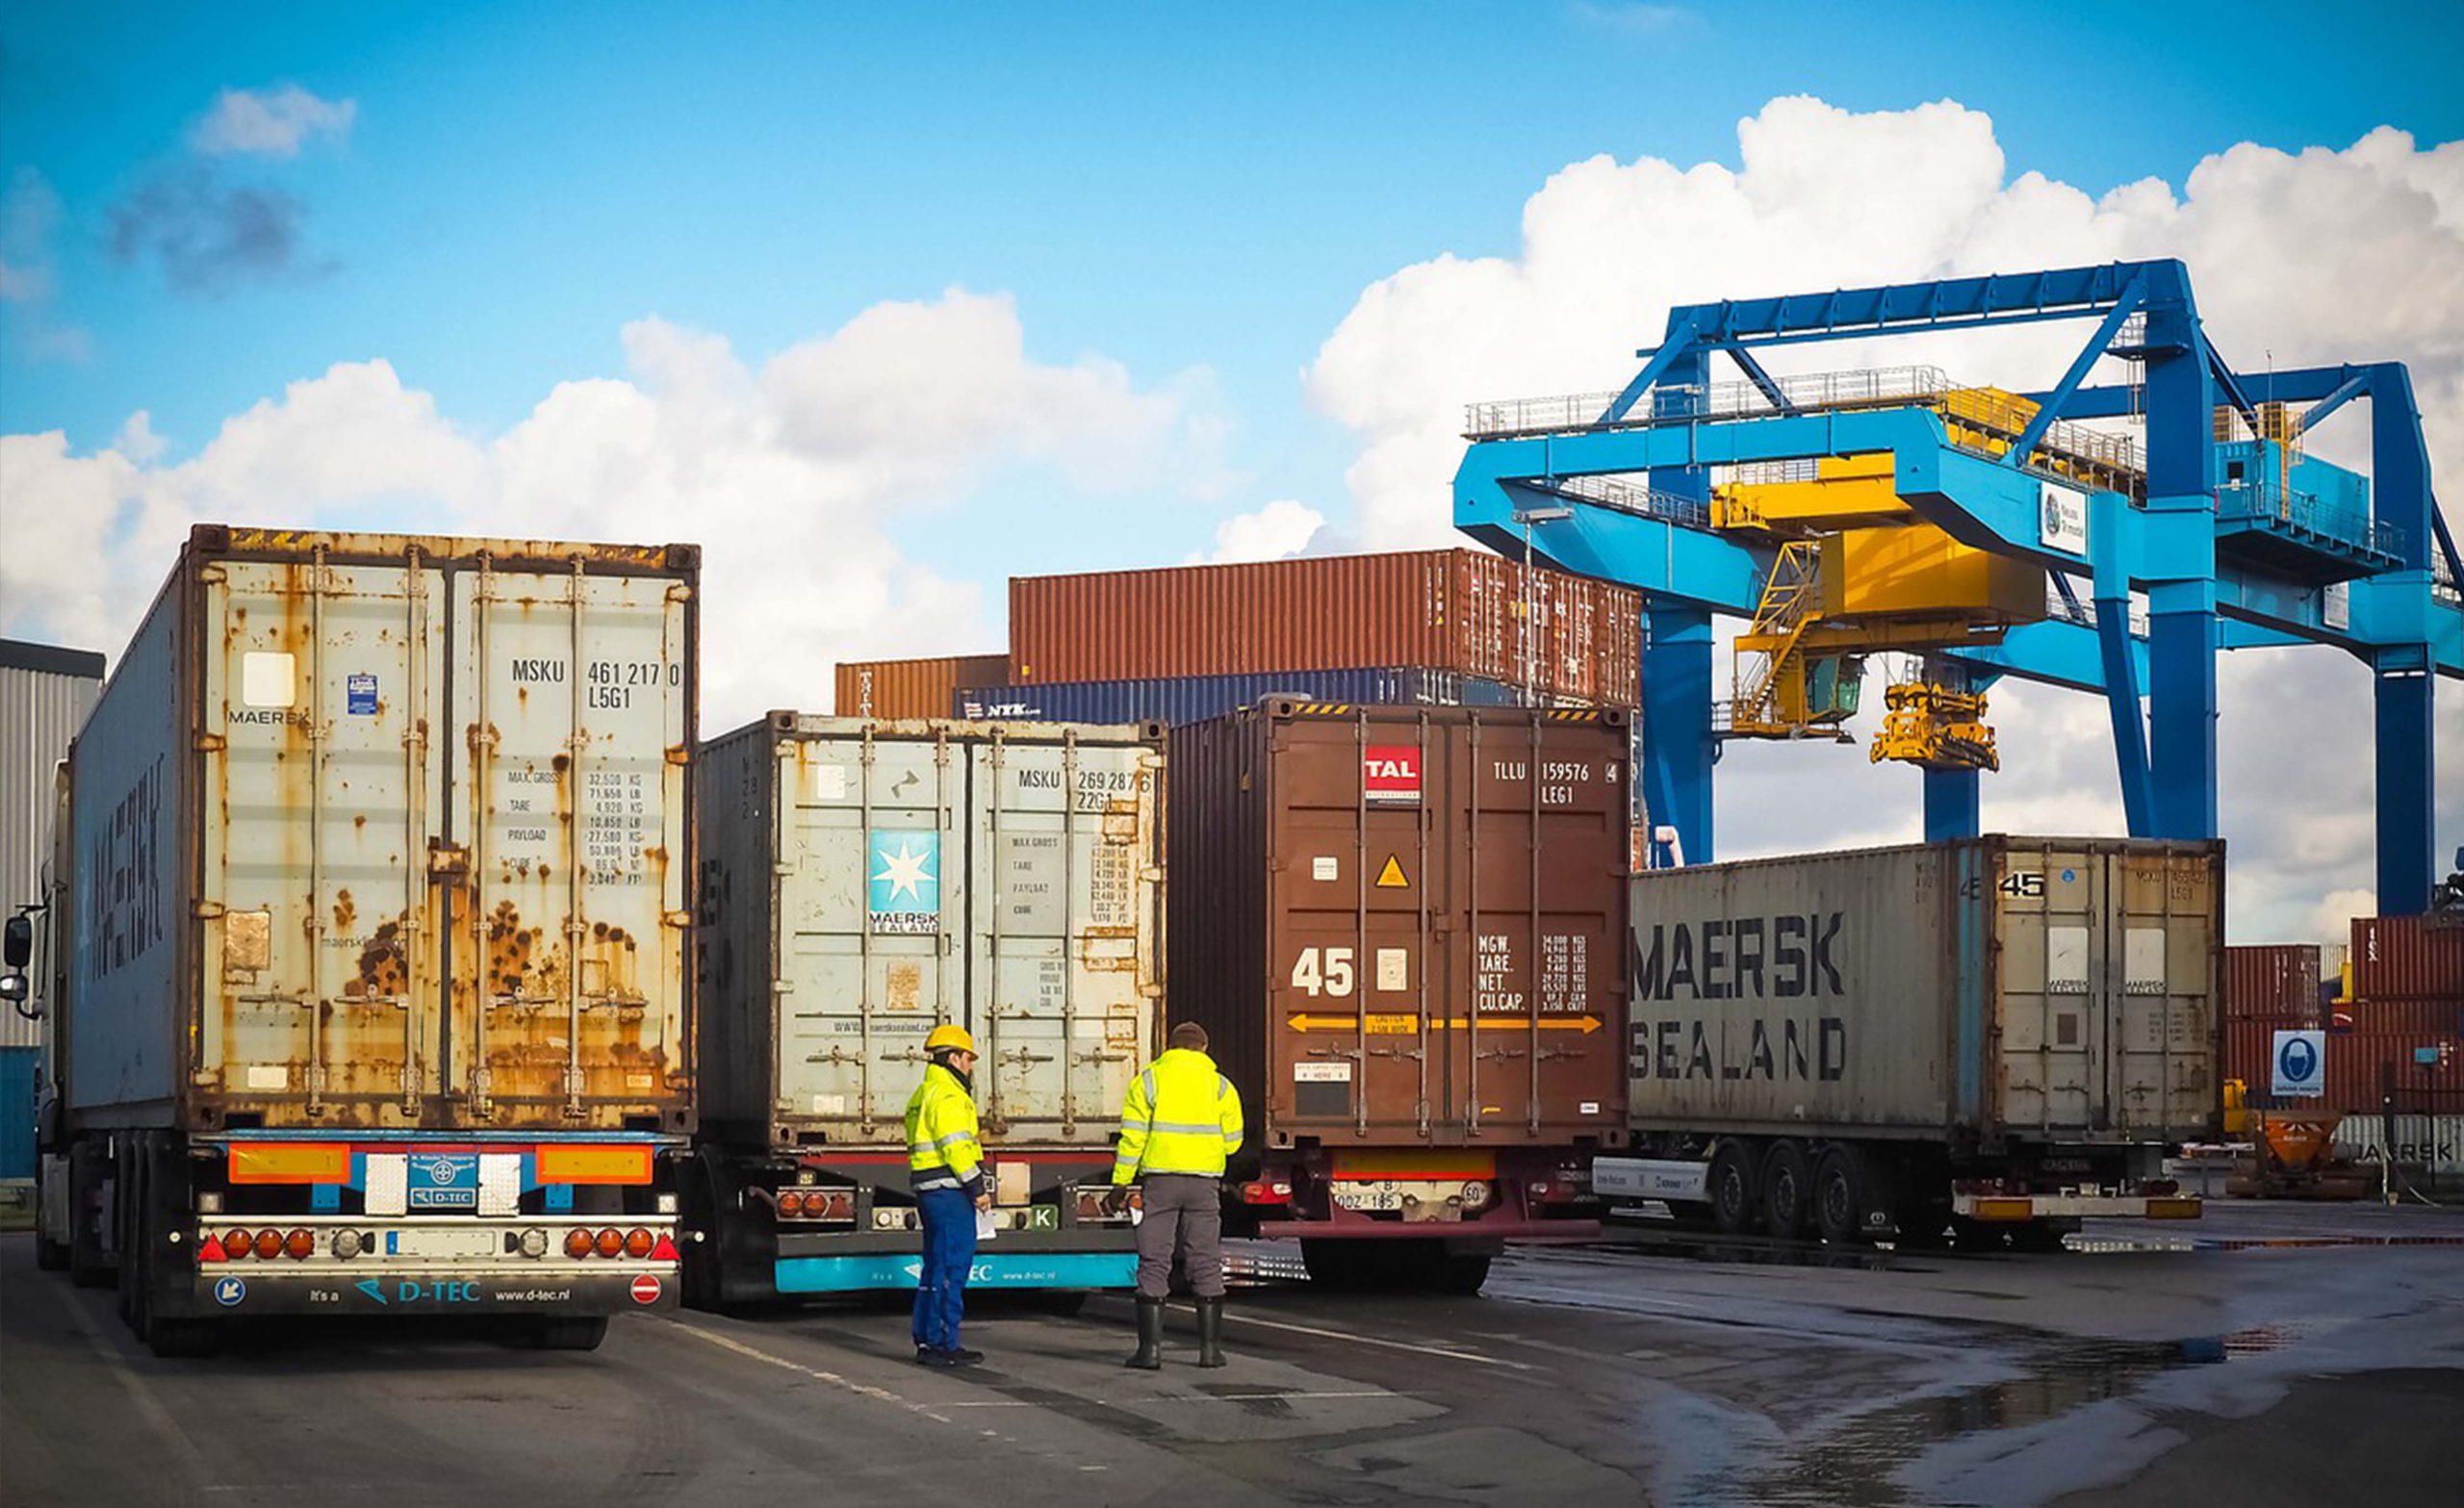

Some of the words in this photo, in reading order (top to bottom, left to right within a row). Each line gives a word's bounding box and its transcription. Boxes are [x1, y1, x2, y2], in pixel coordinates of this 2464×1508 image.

[513, 658, 565, 682] MSKU
[588, 662, 620, 684] 461
[628, 663, 659, 685] 217
[669, 663, 681, 687] 0
[589, 687, 630, 709] L5G1
[228, 710, 312, 725] MAERSK
[988, 703, 1026, 717] NYK
[1366, 760, 1416, 778] TAL
[1495, 763, 1526, 780] TLLU
[1543, 763, 1589, 781] 159576
[1019, 770, 1060, 788] MSKU
[1078, 772, 1105, 790] 269
[510, 801, 531, 812] TARE
[1077, 791, 1113, 810] 22G1
[508, 830, 547, 842] PAYLOAD
[1999, 873, 2044, 897] 45
[869, 913, 939, 924] MAERSK
[1479, 935, 1511, 953] MGW.
[1479, 955, 1514, 972] TARE.
[1630, 911, 1844, 1002] MAERSK
[1292, 947, 1353, 997] 45
[1479, 974, 1506, 991] NET.
[1479, 992, 1525, 1010] CU.CAP.
[1630, 1017, 1845, 1081] SEALAND
[2357, 1143, 2452, 1161] ARSK
[436, 1193, 470, 1202] D-TEC
[1035, 1210, 1049, 1228] K
[398, 1281, 480, 1302] D-TEC
[496, 1290, 570, 1301] www.d-tec.nl
